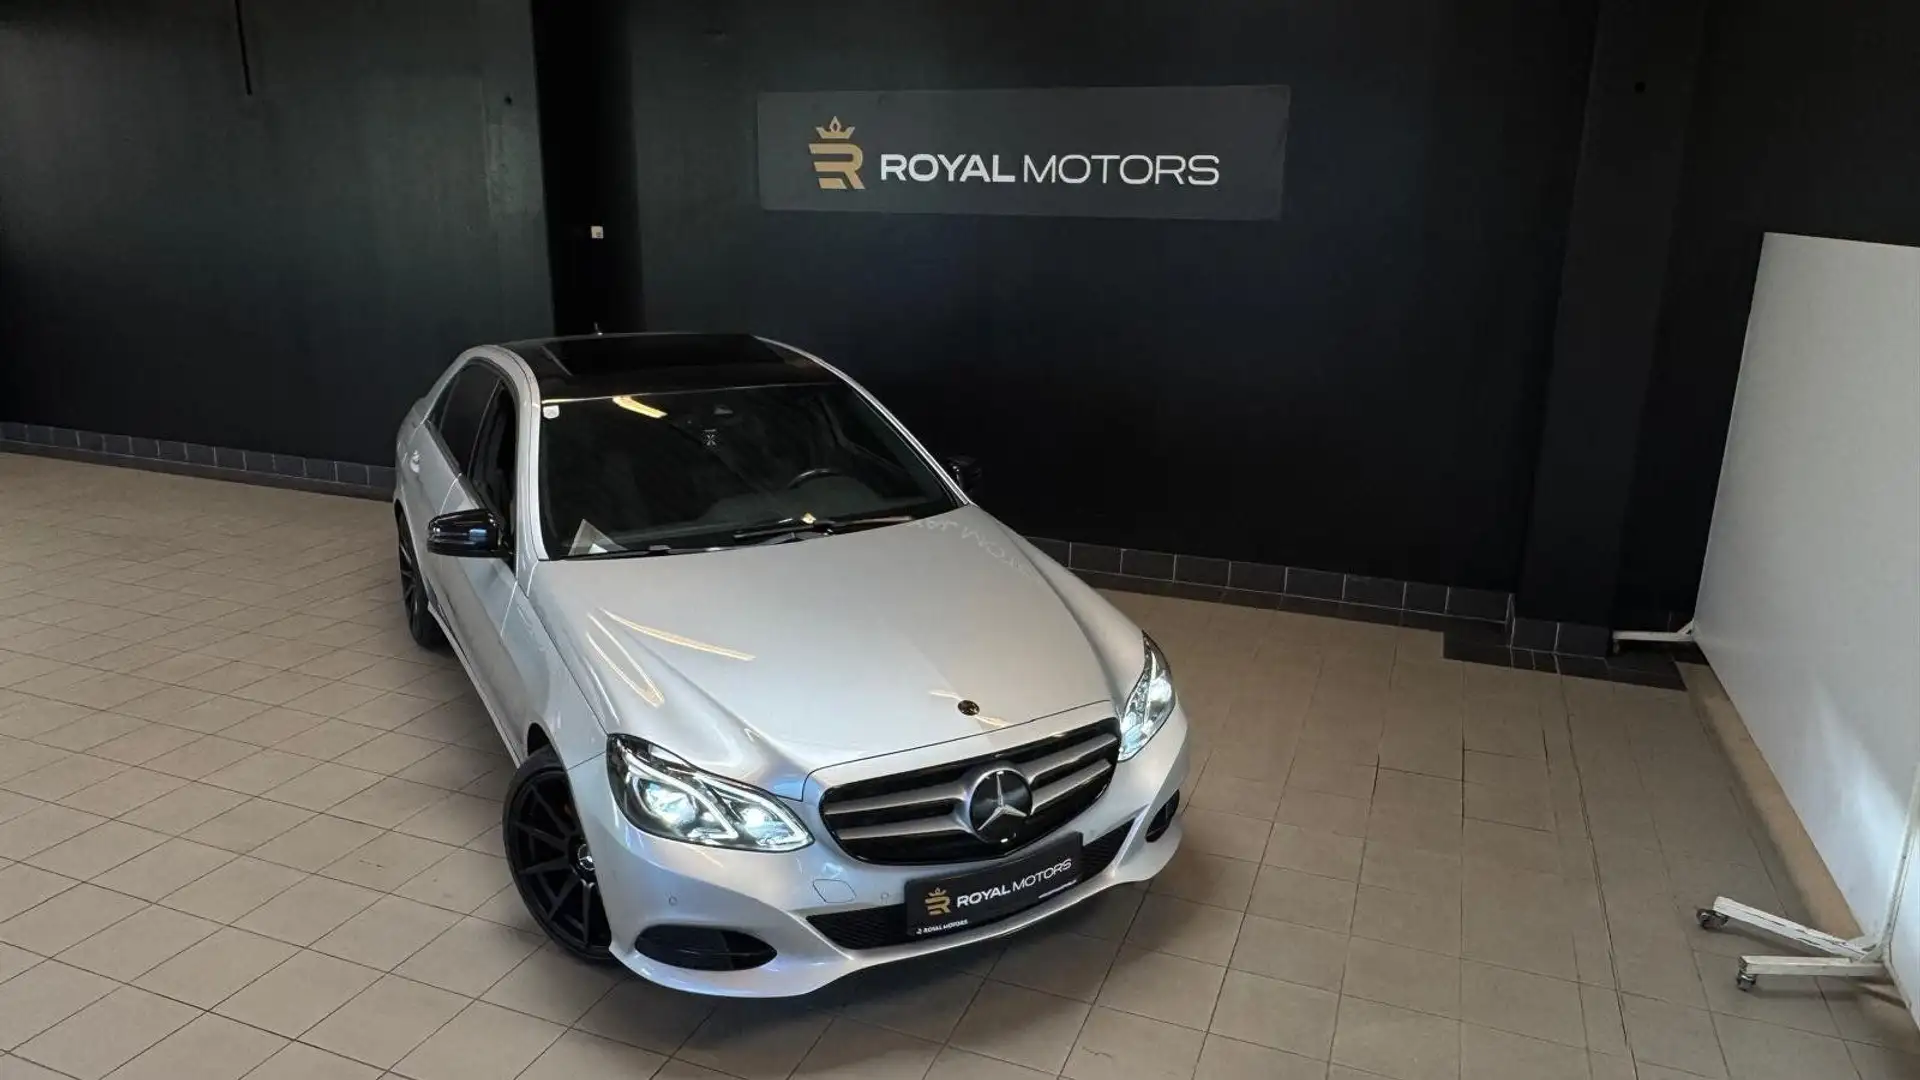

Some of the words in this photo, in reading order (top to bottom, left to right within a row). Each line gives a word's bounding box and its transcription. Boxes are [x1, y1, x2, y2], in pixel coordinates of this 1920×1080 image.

[880, 153, 1016, 183] ROYAL
[1023, 154, 1220, 186] MOTORS
[956, 884, 1011, 909] ROYAL
[1012, 858, 1072, 892] MOTORS
[922, 924, 942, 934] ROYAL
